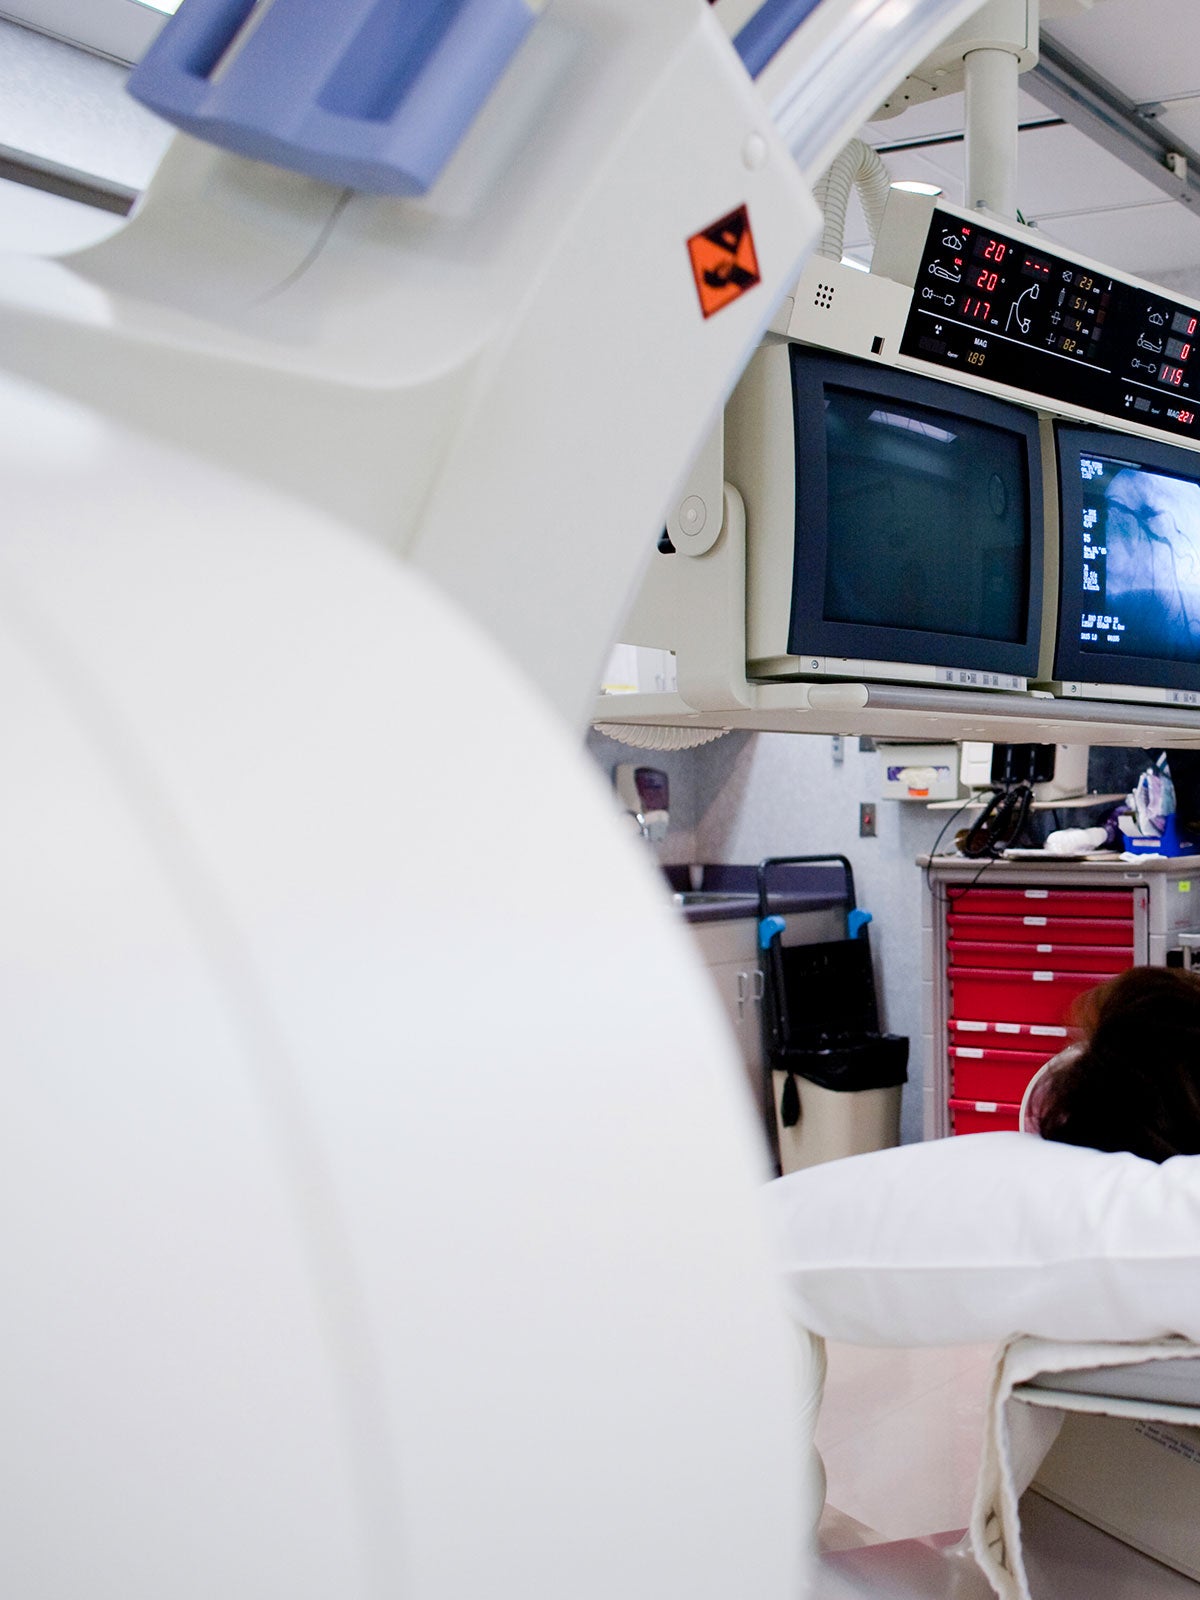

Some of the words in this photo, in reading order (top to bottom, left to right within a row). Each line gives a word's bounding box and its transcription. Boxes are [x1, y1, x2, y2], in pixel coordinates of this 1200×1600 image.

[1079, 276, 1093, 290] 23
[963, 298, 991, 320] 117
[1074, 297, 1087, 311] 51
[1075, 320, 1082, 331] 4
[973, 337, 988, 348] MAG
[1063, 338, 1076, 352] 82
[1162, 365, 1183, 385] 115
[1166, 408, 1180, 419] MAG
